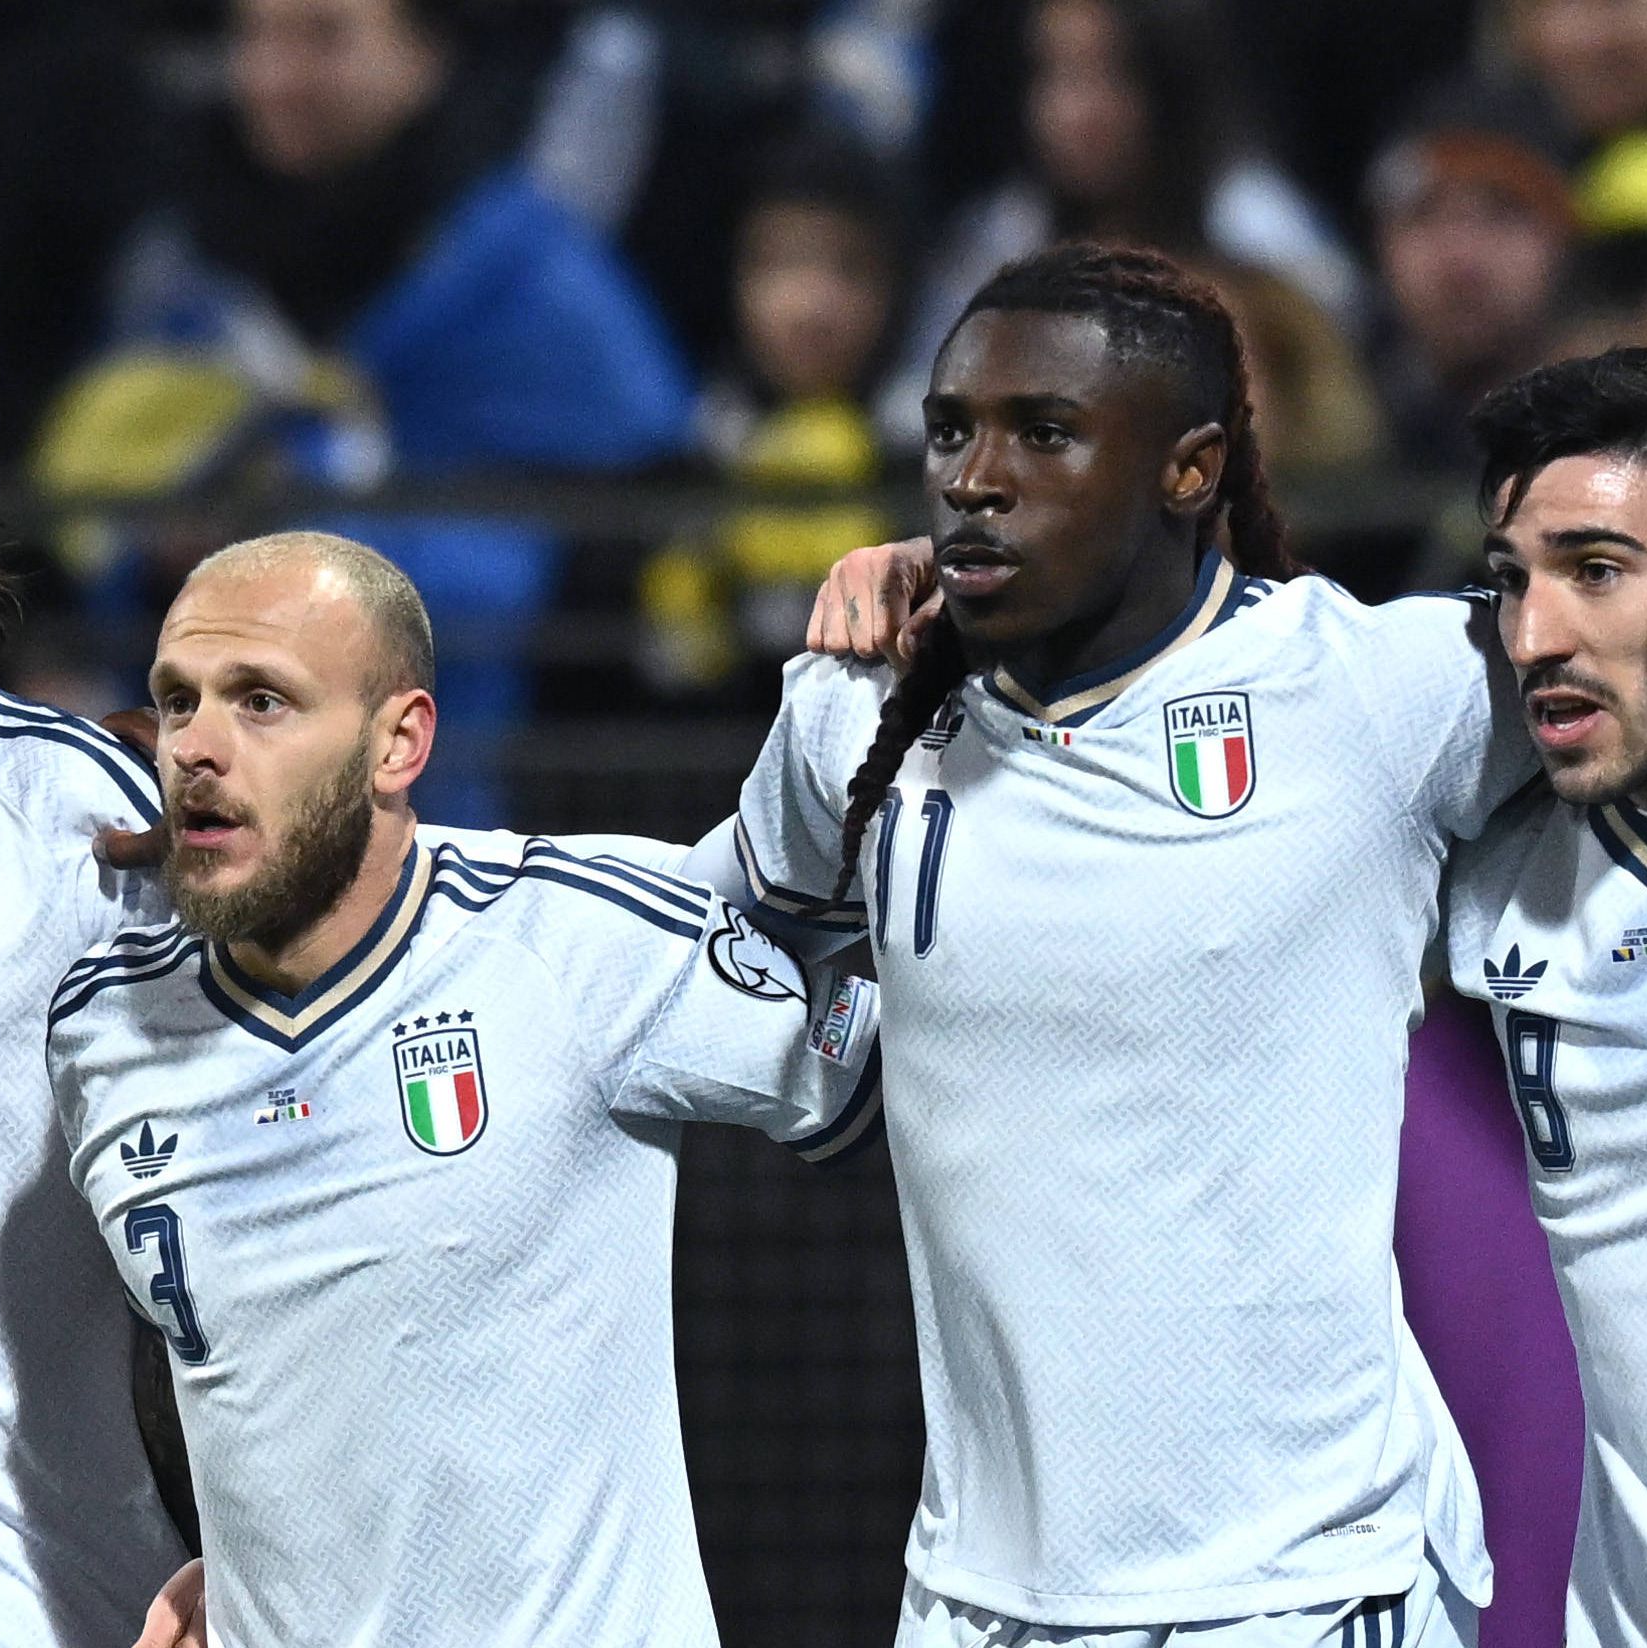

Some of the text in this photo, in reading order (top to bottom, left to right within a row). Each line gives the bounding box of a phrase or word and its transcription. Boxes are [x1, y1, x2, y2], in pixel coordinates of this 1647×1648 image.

[1171, 701, 1242, 730] ITALIA
[875, 786, 956, 960] 11
[401, 1038, 471, 1070] ITALIA
[821, 986, 853, 1058] FOUND
[1505, 1008, 1577, 1171] 8
[125, 1203, 210, 1366] 3
